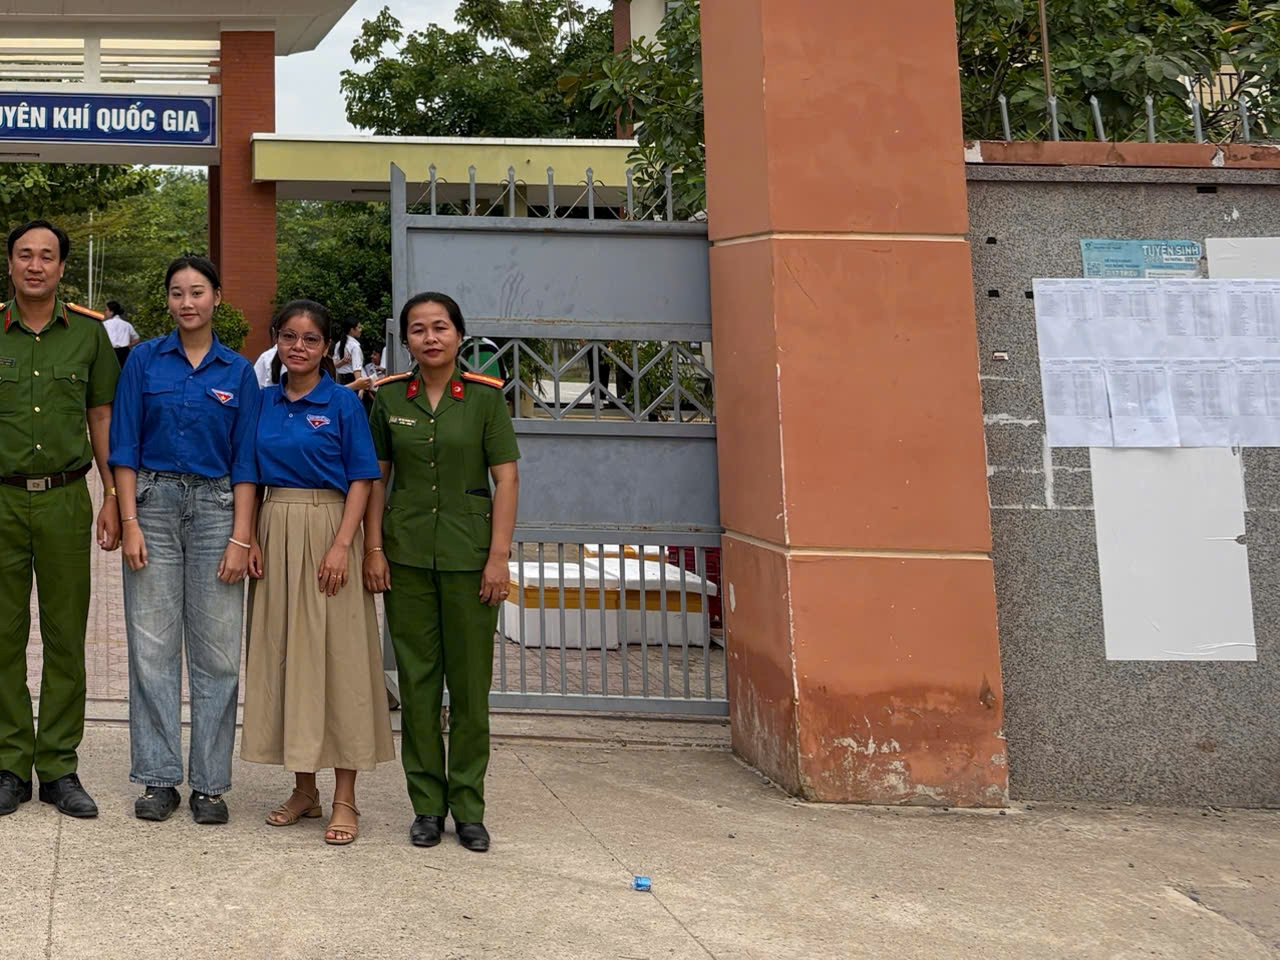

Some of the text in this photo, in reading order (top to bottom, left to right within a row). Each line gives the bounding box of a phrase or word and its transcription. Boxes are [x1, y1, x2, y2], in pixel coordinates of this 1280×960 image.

[53, 103, 91, 130] KHÍ
[96, 101, 155, 132] QUỐC
[162, 109, 200, 133] GIA
